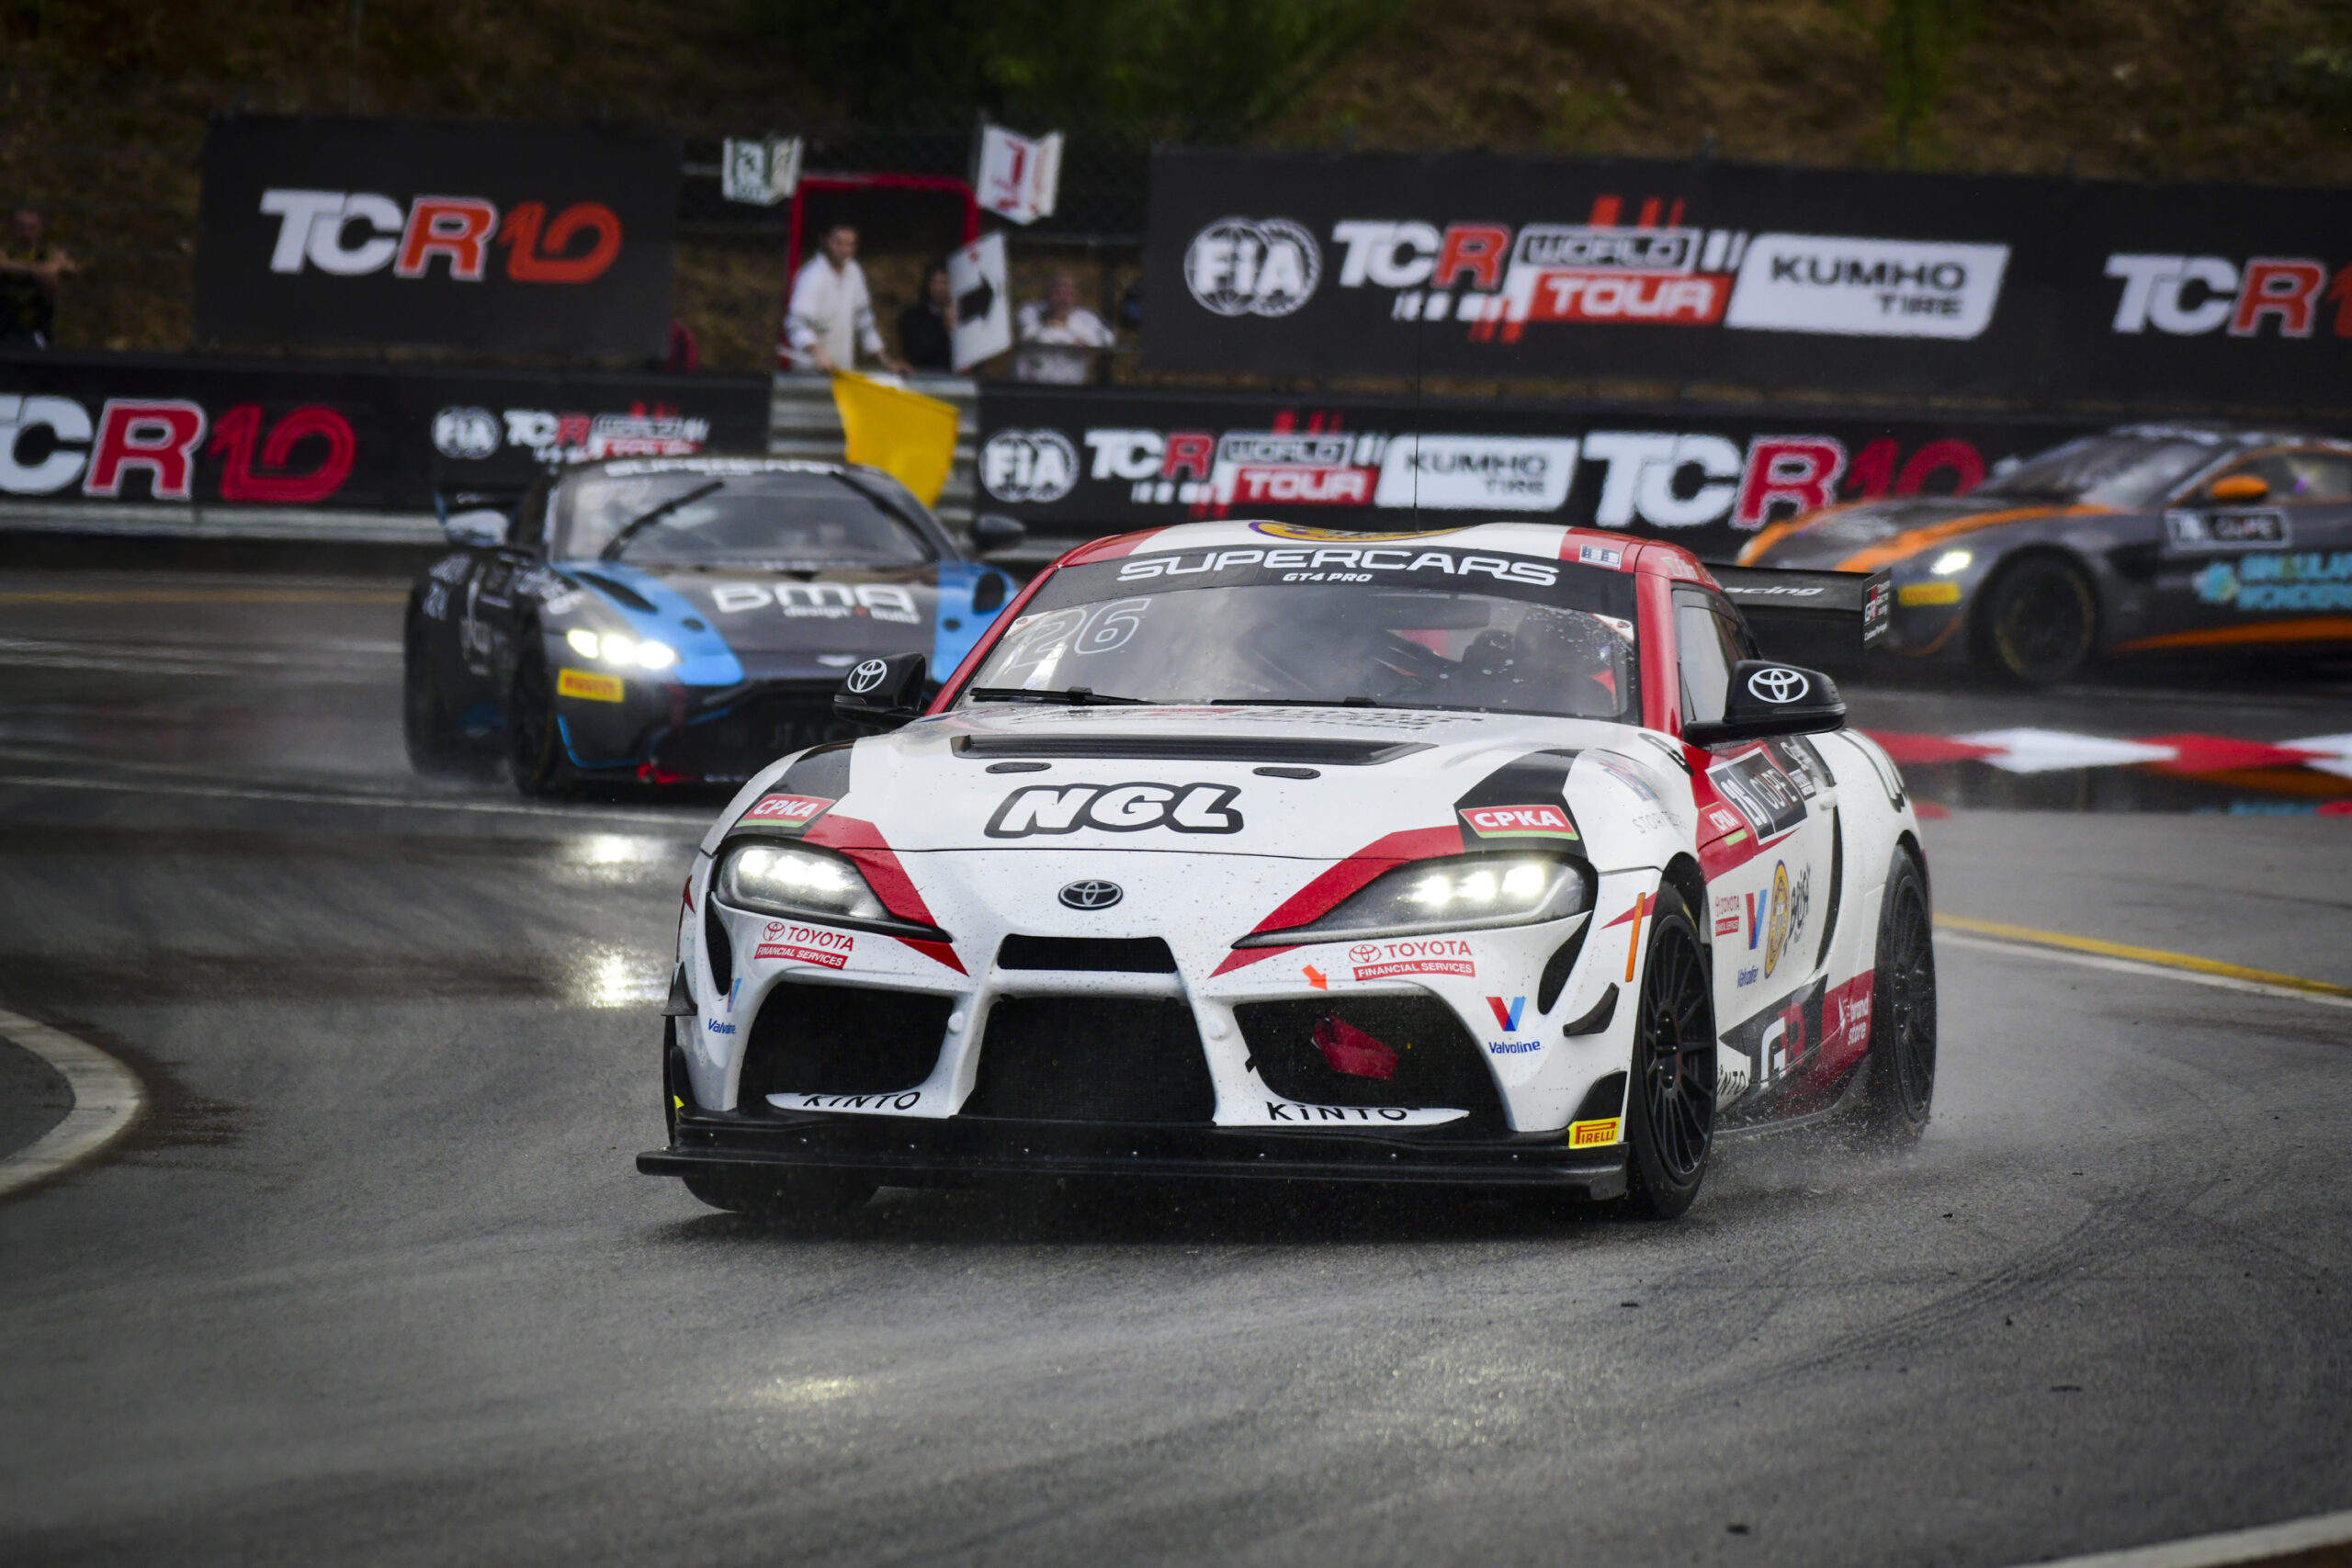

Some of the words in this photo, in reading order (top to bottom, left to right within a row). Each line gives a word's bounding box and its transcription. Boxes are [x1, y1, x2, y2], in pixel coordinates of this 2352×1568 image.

[1331, 220, 1509, 289] TCR
[1527, 232, 1678, 268] WORLD
[1770, 254, 1966, 290] KUMHO
[1545, 277, 1715, 318] TOUR
[1877, 293, 1964, 318] TIRE
[503, 410, 593, 446] TCR
[1084, 429, 1214, 480] TCR
[1227, 439, 1340, 460] WORLD
[1406, 452, 1546, 475] KUMHO
[1242, 471, 1362, 498] TOUR
[1483, 479, 1545, 495] TIRE
[1116, 548, 1560, 586] SUPERCARS
[1283, 571, 1325, 582] GT4
[1329, 572, 1374, 583] PRO
[1725, 586, 1825, 596] acing
[1011, 597, 1152, 670] 26
[753, 799, 819, 817] CPKA
[984, 782, 1244, 838] NGL
[1474, 810, 1566, 828] CPKA
[787, 926, 854, 952] TOYOTA
[1385, 941, 1473, 958] TOYOTA
[757, 946, 795, 957] FINANCIAL
[797, 950, 843, 967] SERVICES
[1358, 963, 1419, 977] FINANCIAL
[1420, 963, 1473, 974] SERVICES
[1488, 1041, 1541, 1055] Valvoline
[1575, 1122, 1616, 1145] PIRELLI
